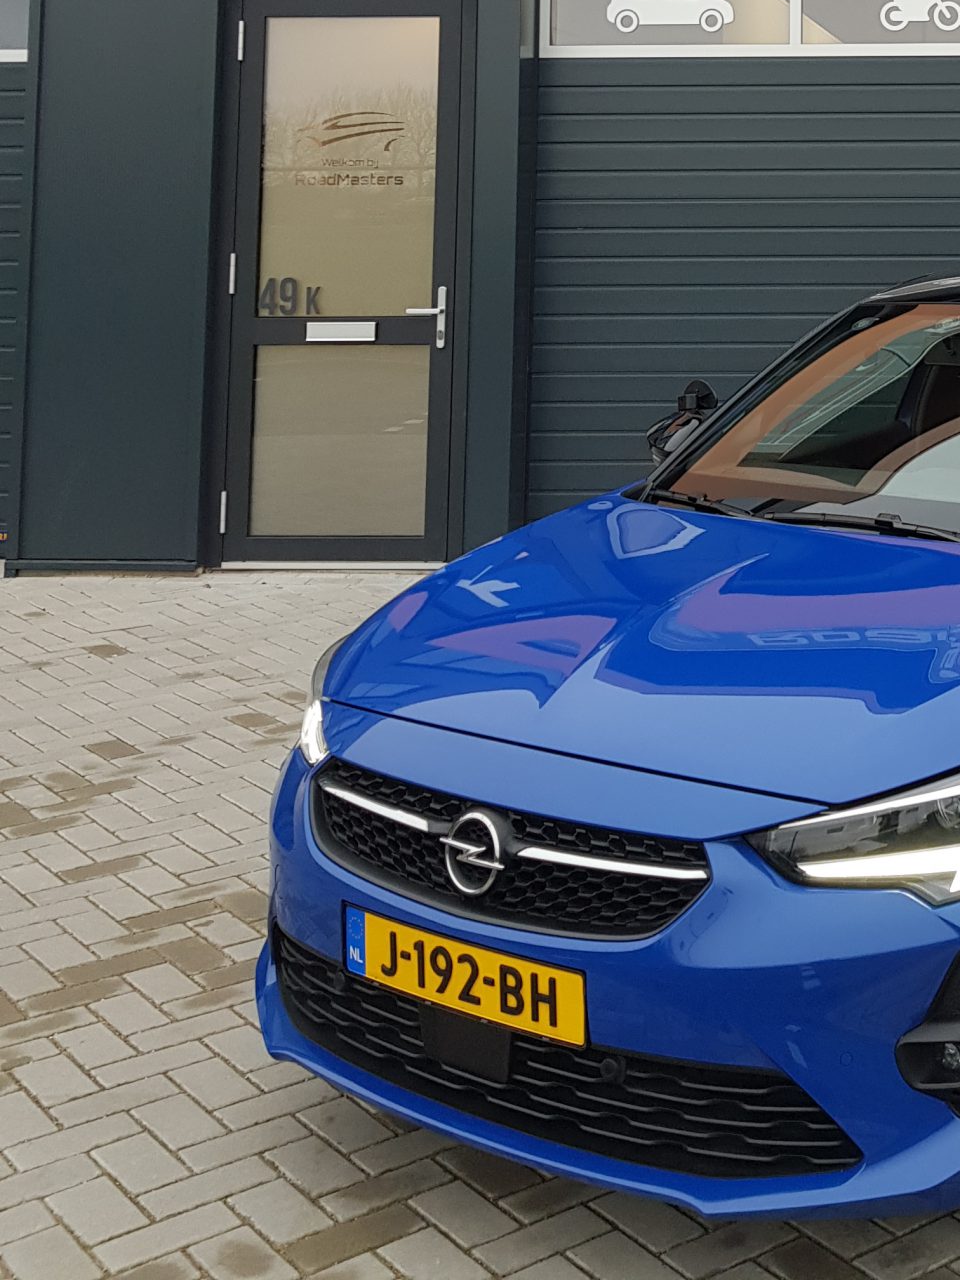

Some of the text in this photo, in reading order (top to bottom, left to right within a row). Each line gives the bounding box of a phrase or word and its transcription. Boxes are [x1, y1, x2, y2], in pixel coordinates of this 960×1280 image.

[321, 158, 364, 167] Welkom
[295, 173, 404, 186] RoadMasters
[260, 277, 321, 315] 49 K
[350, 945, 363, 964] NL
[381, 931, 557, 1028] J-192-BH
